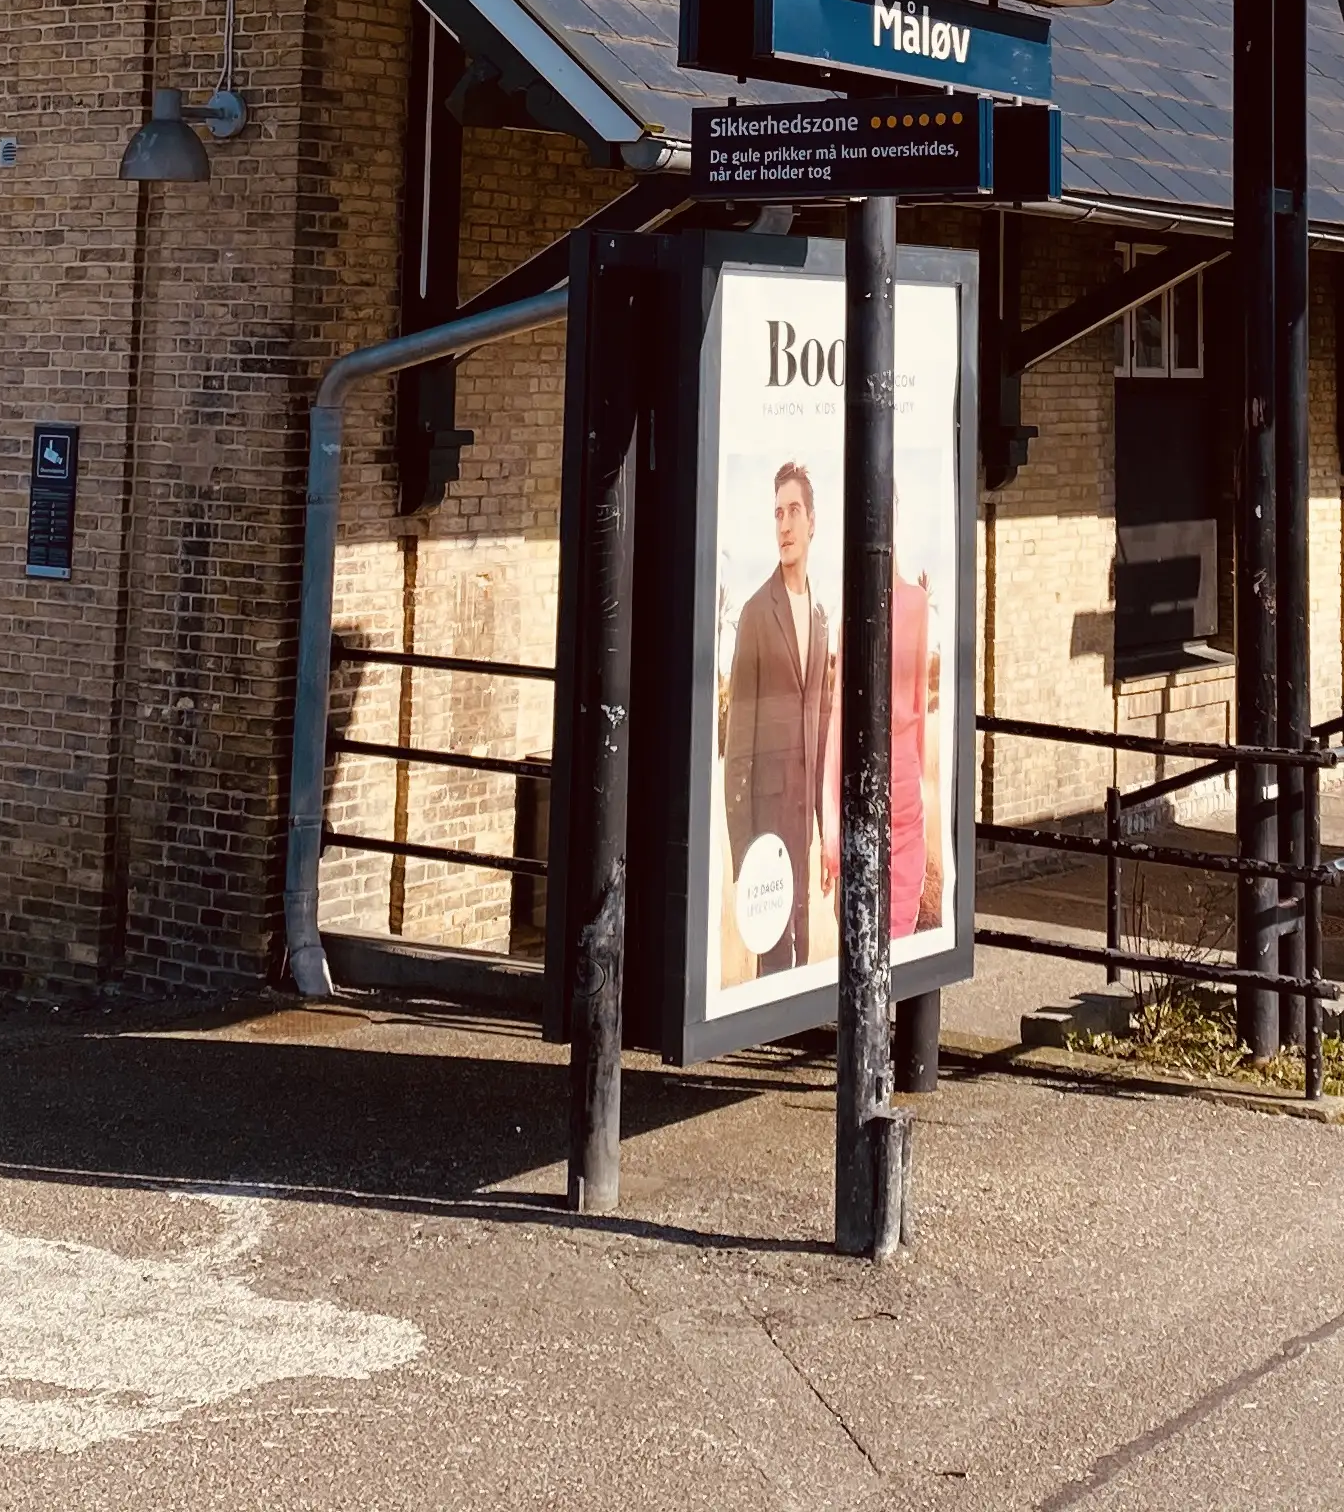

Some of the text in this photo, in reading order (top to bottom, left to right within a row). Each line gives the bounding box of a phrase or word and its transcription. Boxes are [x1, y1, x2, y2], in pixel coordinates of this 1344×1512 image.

[710, 113, 859, 138] Sikkerhedszone
[710, 140, 959, 166] De gule prikker må kun overskrides,
[710, 164, 832, 182] når der holder tog
[764, 319, 916, 389] Boo COM
[762, 402, 836, 416] FASHION KIDS
[760, 878, 784, 896] DAGES
